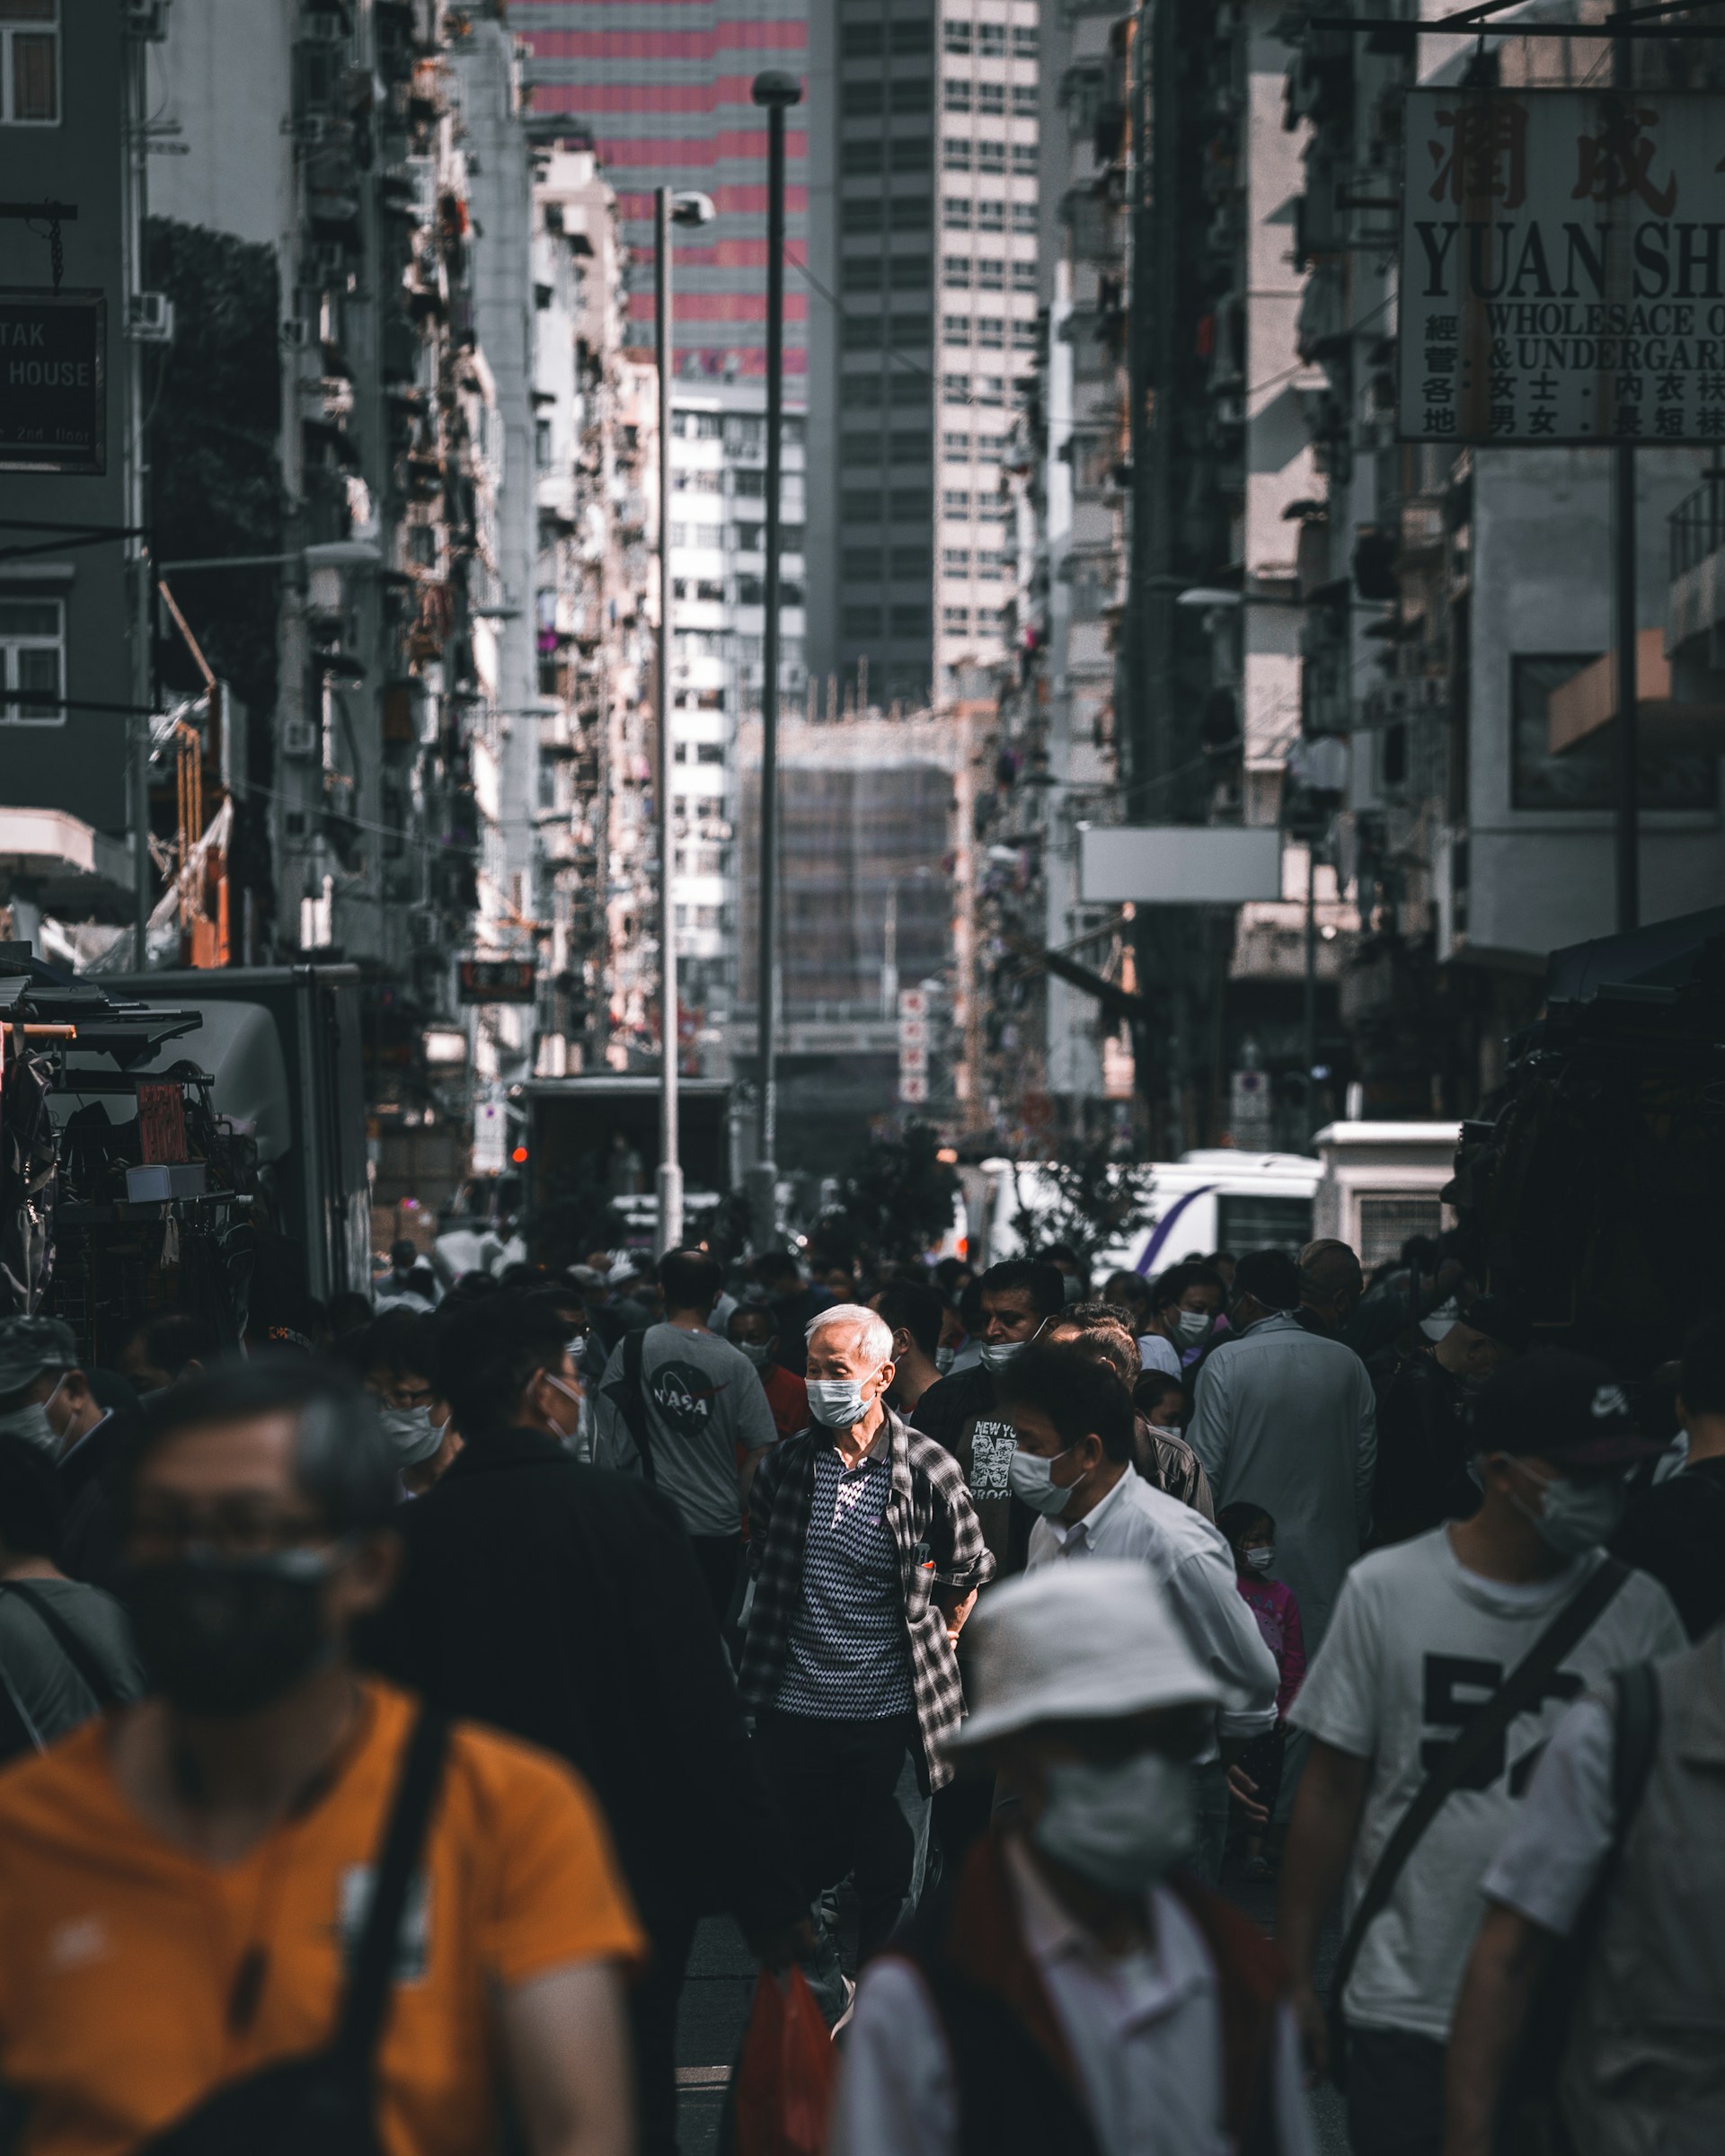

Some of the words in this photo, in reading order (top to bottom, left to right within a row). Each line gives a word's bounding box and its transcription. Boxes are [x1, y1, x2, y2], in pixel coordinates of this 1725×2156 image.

[1427, 96, 1725, 218] 潤成
[1413, 221, 1615, 299] YUAN
[1632, 221, 1725, 299] SH
[9, 360, 89, 386] HOUSE
[653, 1388, 708, 1416] NASA
[975, 1420, 1001, 1436] NEW
